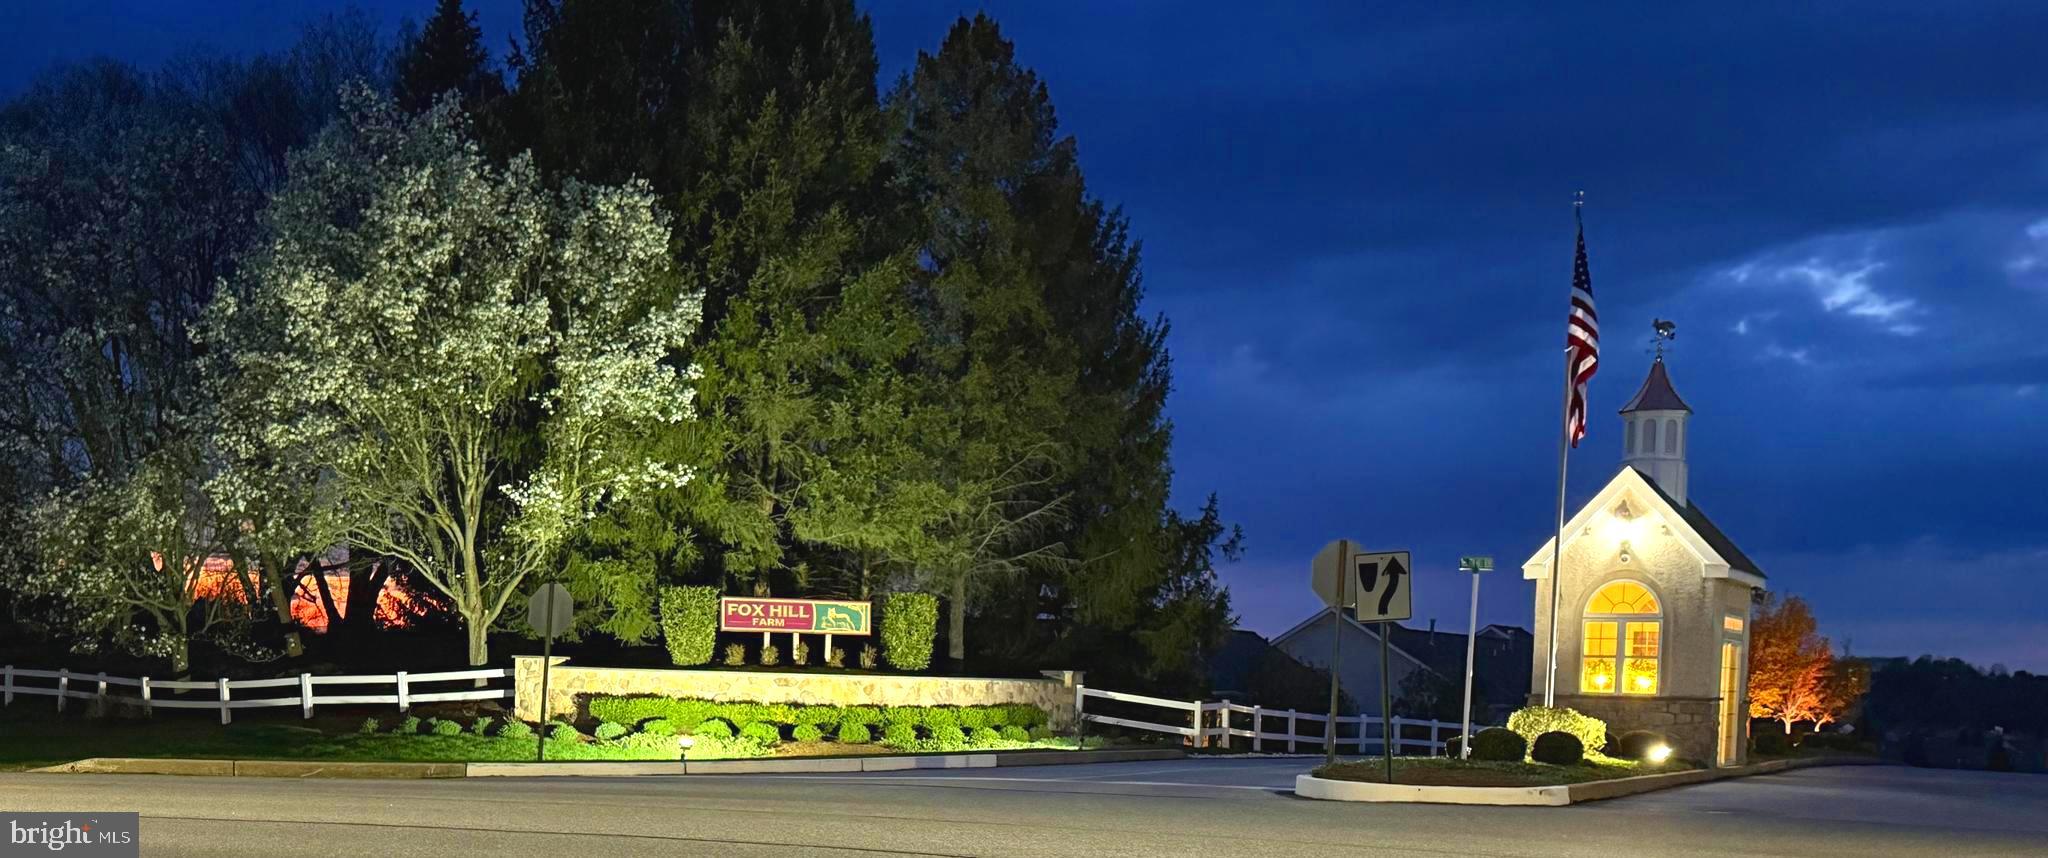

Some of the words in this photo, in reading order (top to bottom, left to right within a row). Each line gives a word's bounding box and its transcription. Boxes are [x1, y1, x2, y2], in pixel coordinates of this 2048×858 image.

[727, 603, 765, 617] FOX
[769, 605, 810, 619] HILL
[752, 618, 785, 628] FARM
